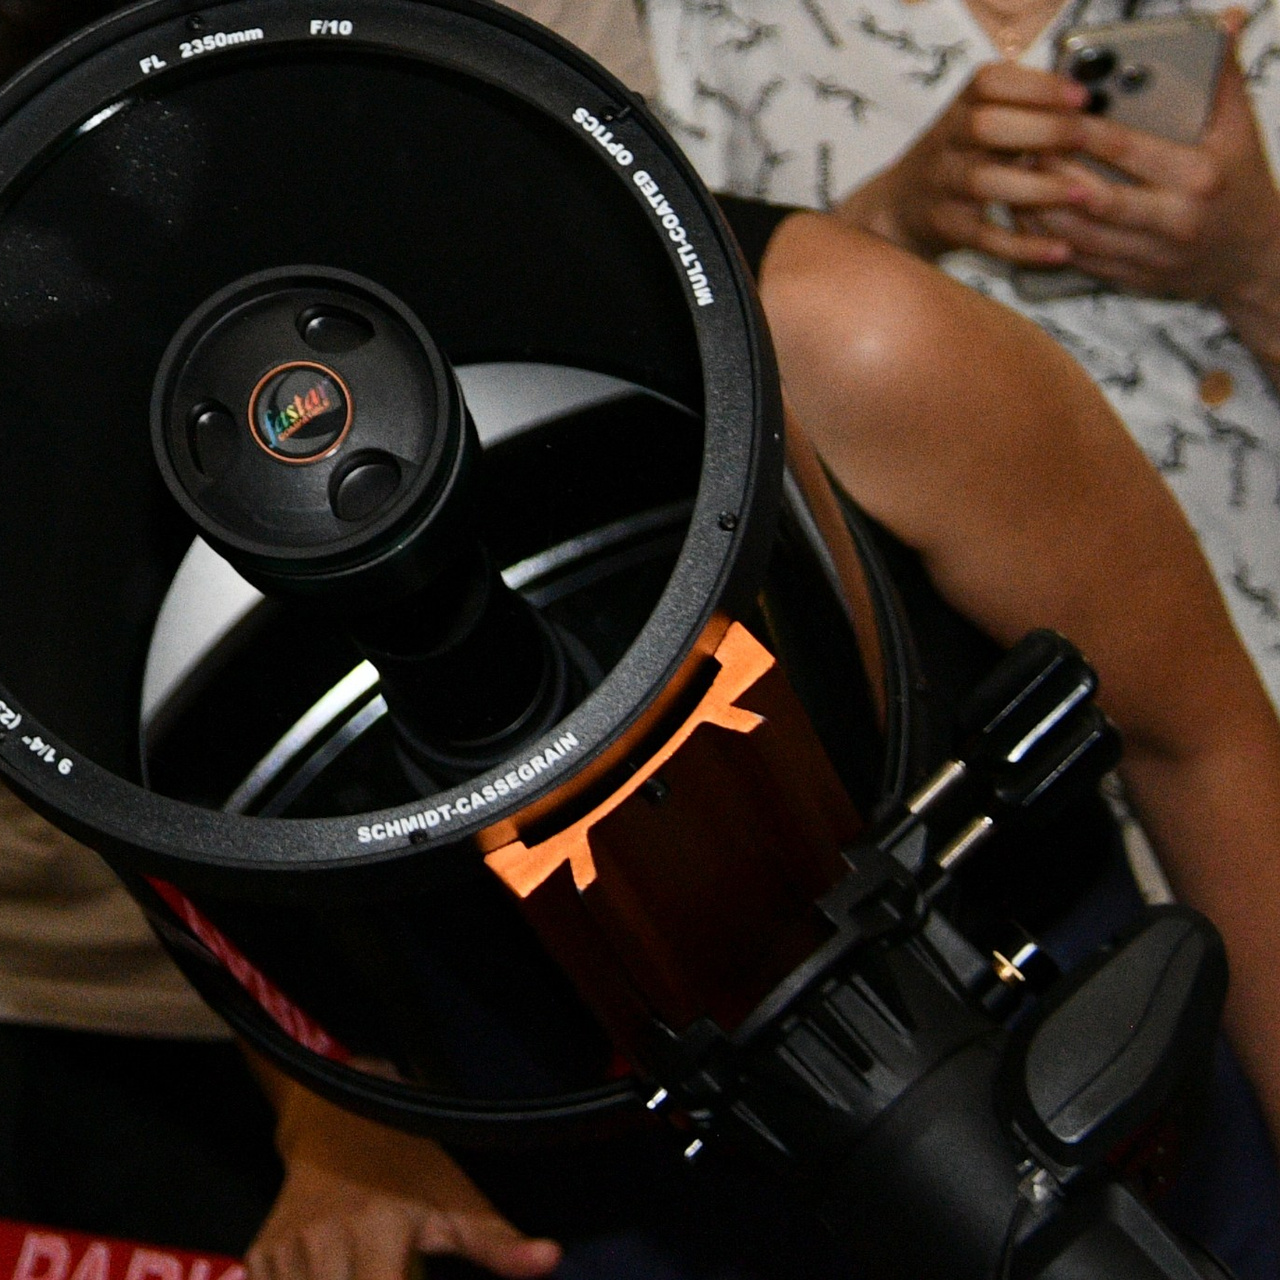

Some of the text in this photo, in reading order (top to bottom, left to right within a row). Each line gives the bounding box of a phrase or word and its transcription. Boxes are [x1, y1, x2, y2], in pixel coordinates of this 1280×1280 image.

[139, 19, 353, 74] FL 2350mm F/10
[571, 107, 715, 307] MULTI-COATED OPTICS
[57, 757, 74, 776] 9
[357, 731, 581, 844] SCHMIDT-CASSEGRAIN
